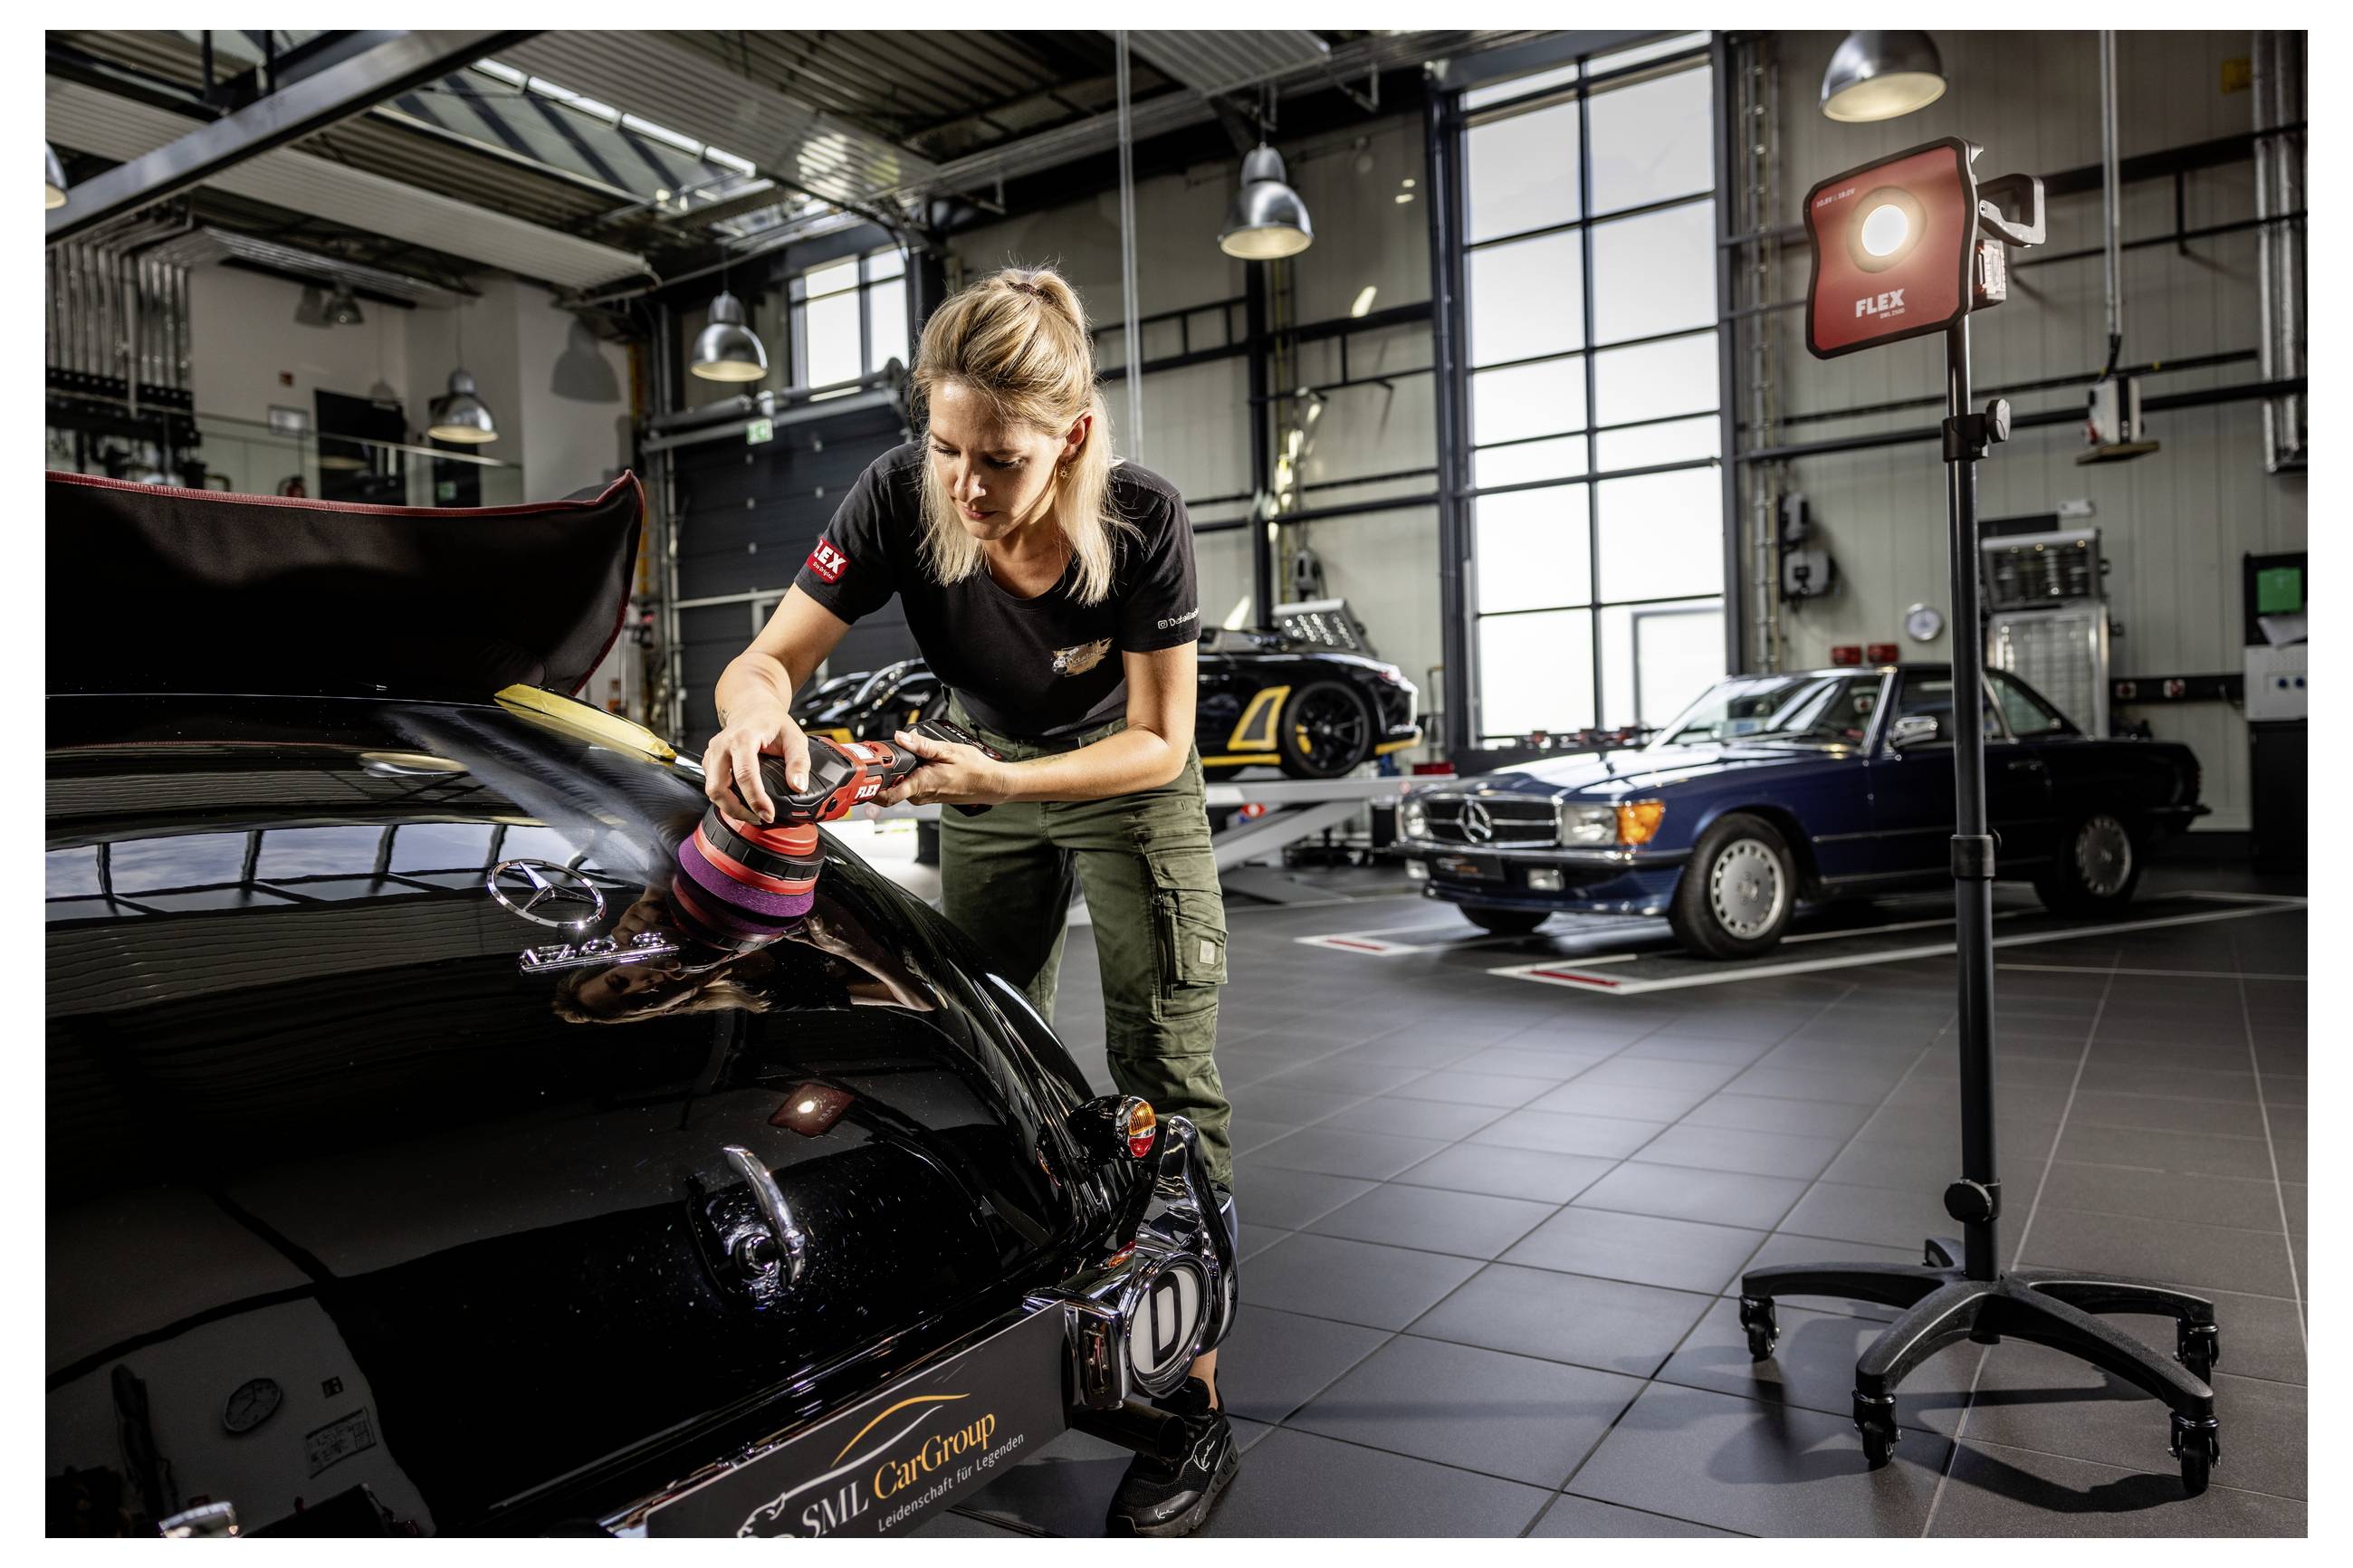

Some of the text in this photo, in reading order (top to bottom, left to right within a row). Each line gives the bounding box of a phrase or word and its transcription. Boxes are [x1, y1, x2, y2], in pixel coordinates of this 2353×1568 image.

[1855, 288, 1905, 319] FLEX
[814, 540, 847, 575] LEX
[854, 783, 882, 799] FLEX
[1148, 1271, 1182, 1371] D
[801, 1412, 996, 1538] SML CarGroup
[877, 1432, 1025, 1533] Leidenschaft für Legenden
